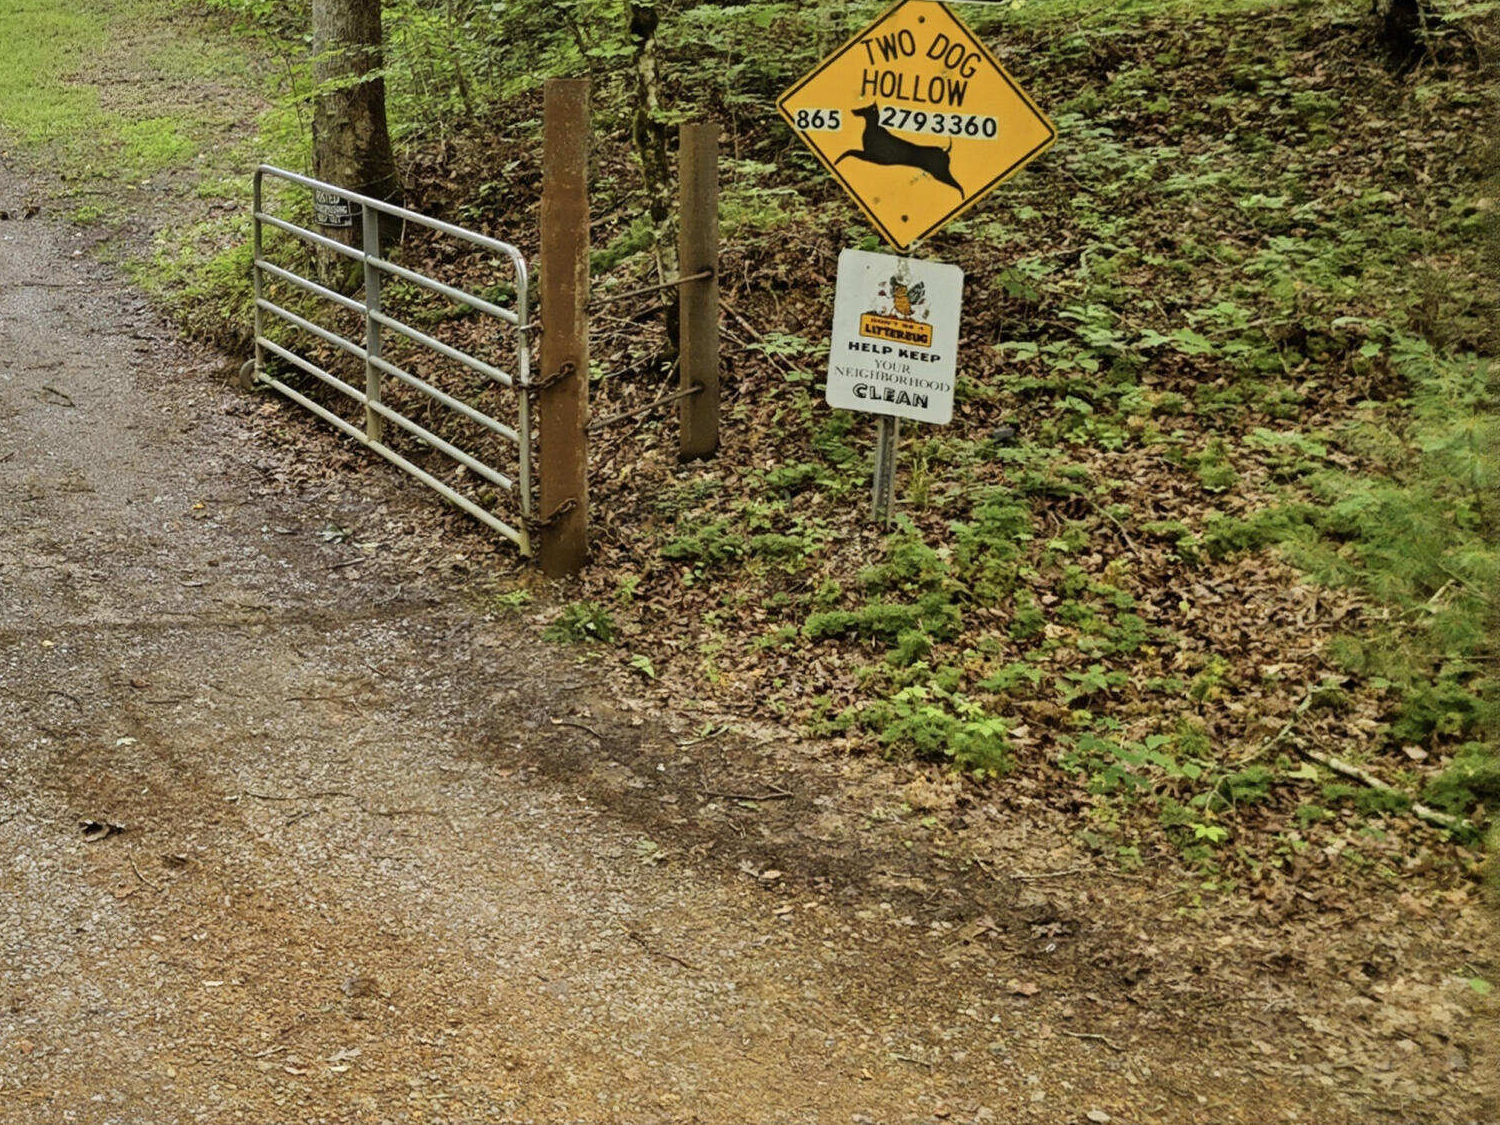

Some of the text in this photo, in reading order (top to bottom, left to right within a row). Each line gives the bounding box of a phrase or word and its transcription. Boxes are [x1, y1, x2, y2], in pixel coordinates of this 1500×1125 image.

[860, 29, 982, 79] TWO DOG
[860, 68, 968, 107] HOLLOW
[796, 106, 998, 138] 865 2793360
[848, 341, 941, 363] HELP KEEP
[835, 366, 951, 393] NEIGHBORHOOD
[874, 359, 911, 374] YOUR
[852, 382, 929, 409] CLEAN
